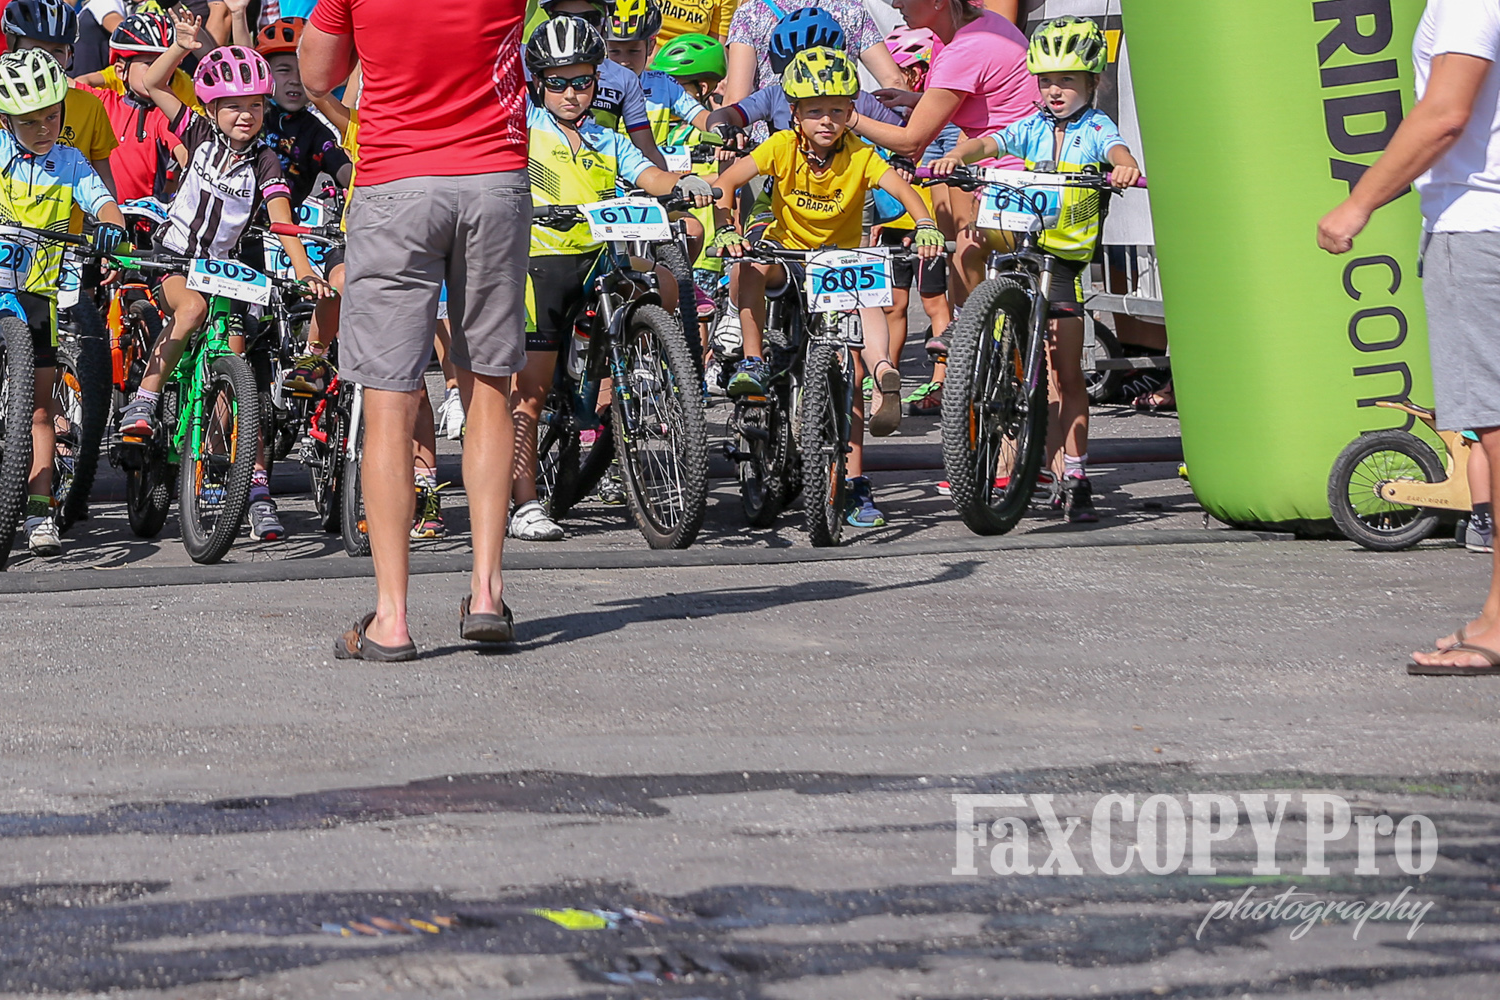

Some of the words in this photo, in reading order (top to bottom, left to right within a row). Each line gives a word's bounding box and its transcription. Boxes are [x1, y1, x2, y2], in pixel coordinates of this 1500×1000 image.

[192, 161, 251, 198] COOLBIKE
[994, 187, 1048, 214] 610
[600, 207, 650, 224] 617
[204, 257, 258, 282] 609
[821, 265, 876, 292] 605
